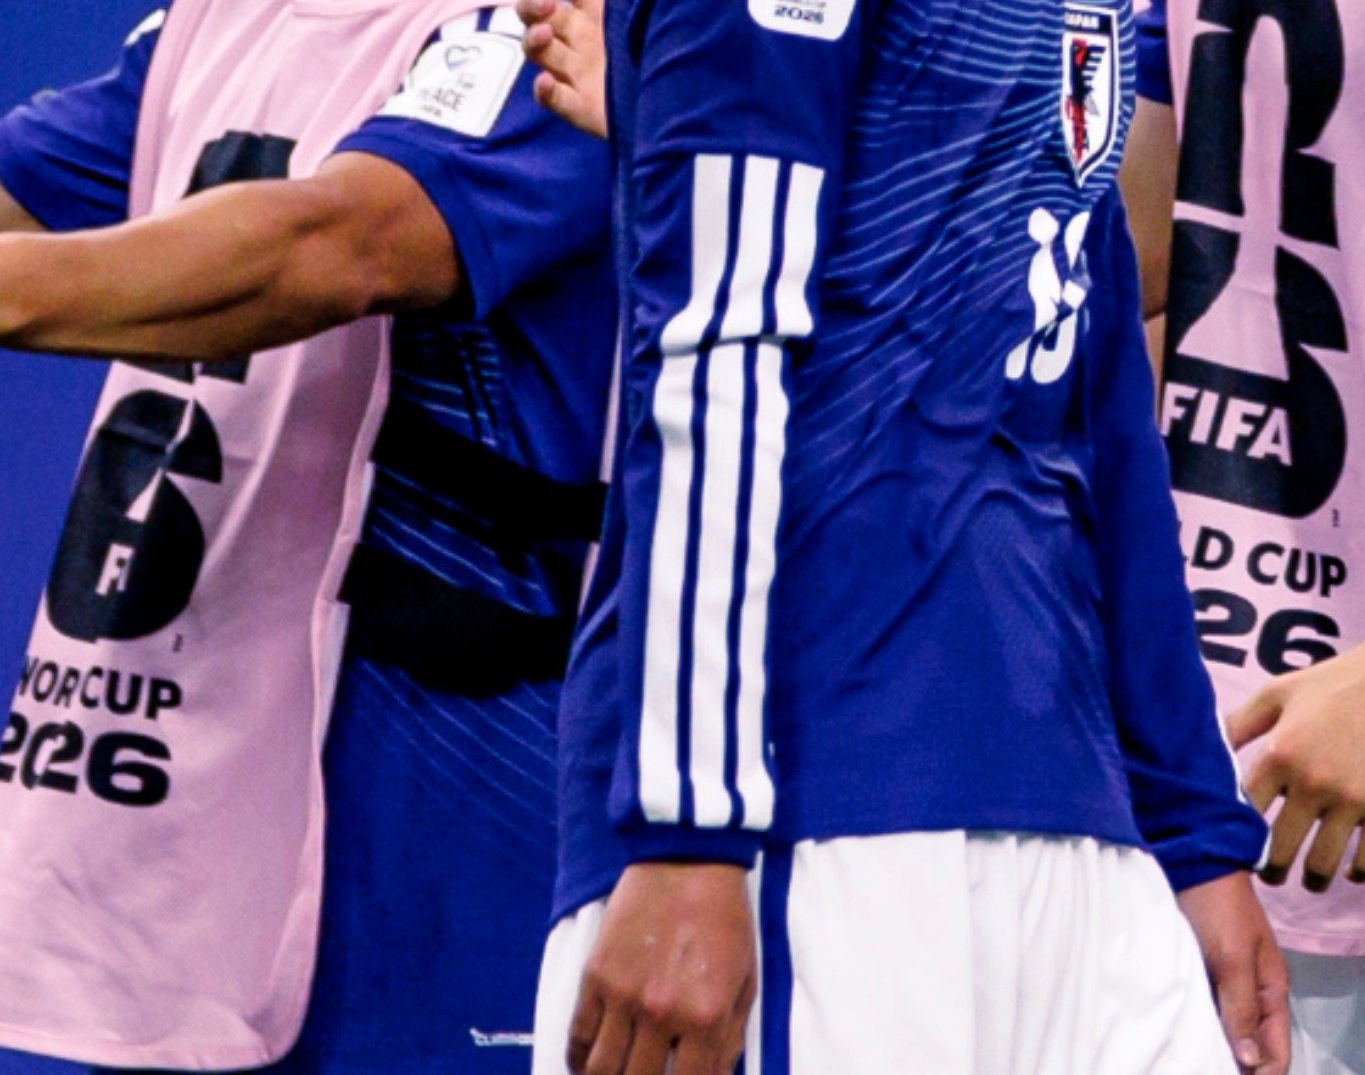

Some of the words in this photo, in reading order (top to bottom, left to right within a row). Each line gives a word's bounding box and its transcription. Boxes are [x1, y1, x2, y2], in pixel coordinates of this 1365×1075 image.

[1160, 381, 1293, 467] FIFA
[1246, 541, 1347, 597] CUP
[80, 665, 183, 721] CUP
